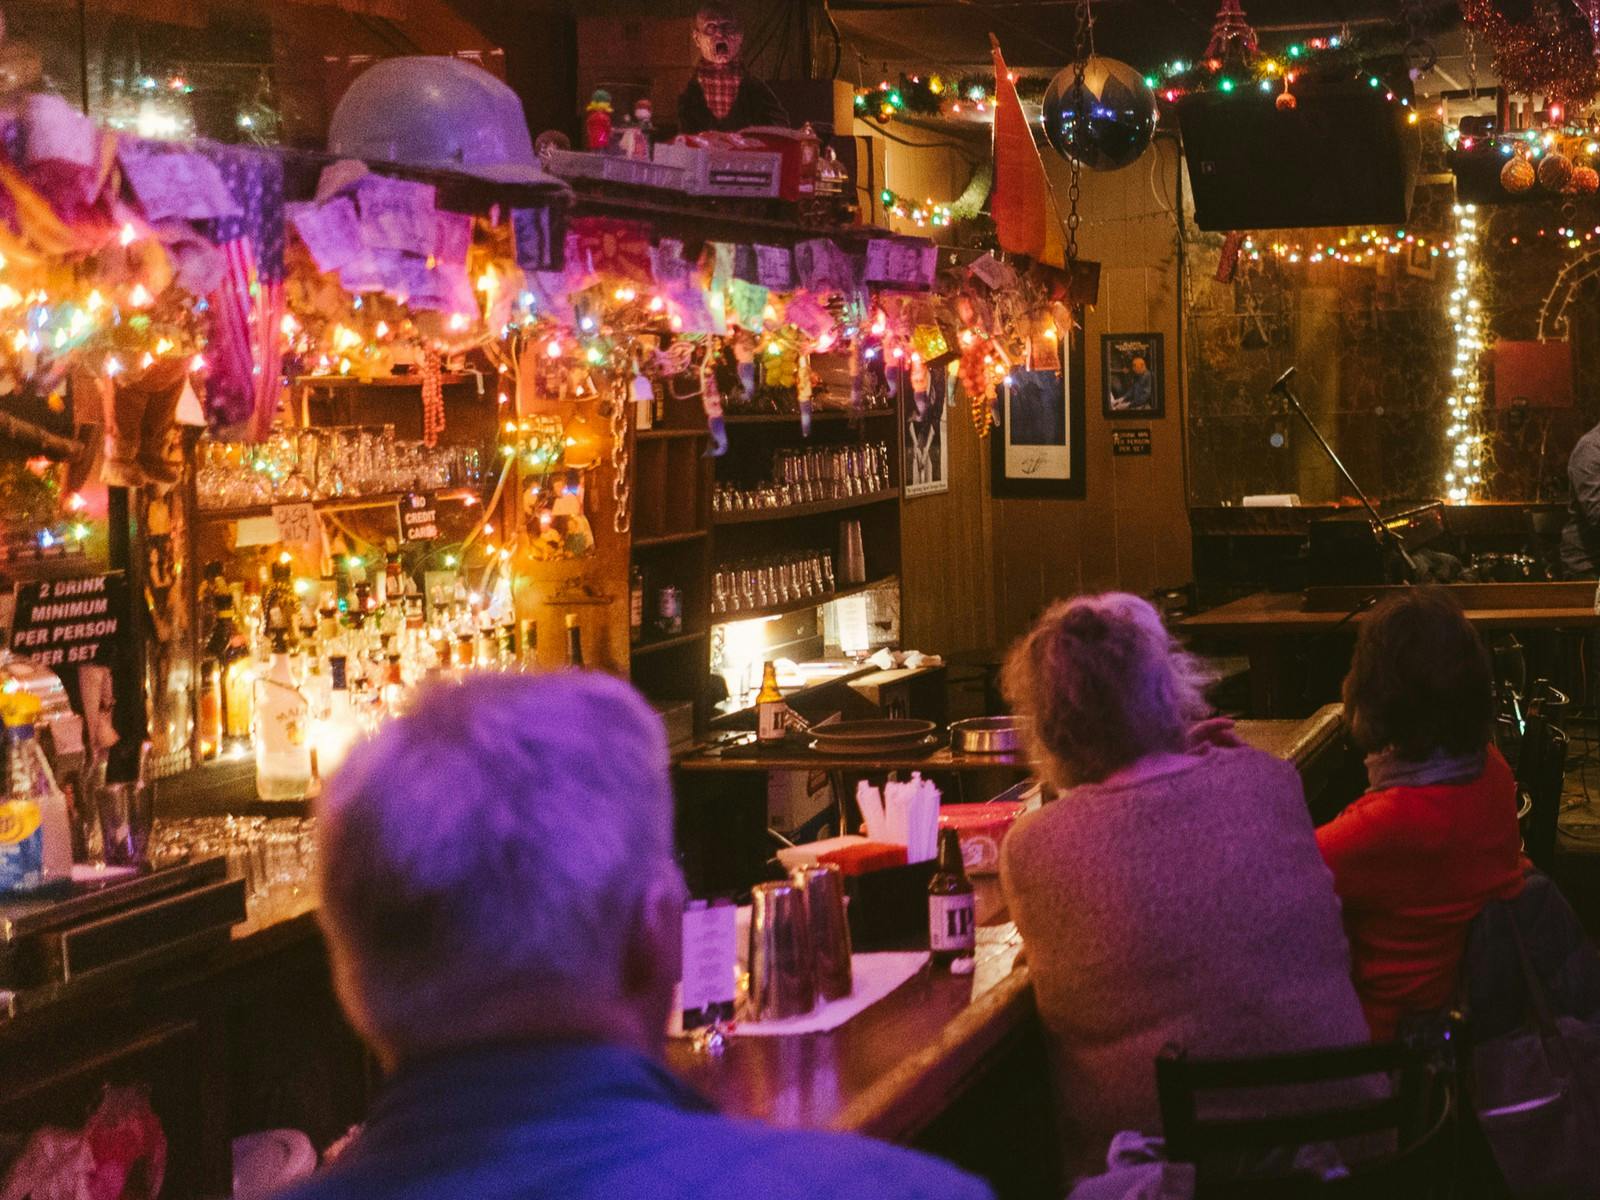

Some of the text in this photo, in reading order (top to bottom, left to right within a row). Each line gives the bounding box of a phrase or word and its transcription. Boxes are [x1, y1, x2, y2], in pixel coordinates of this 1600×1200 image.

[411, 495, 427, 508] NO
[405, 510, 436, 525] CREDIT
[408, 525, 438, 539] CARDS
[38, 576, 107, 599] 2 DRINK
[31, 598, 108, 622] MINIMUM
[14, 617, 118, 648] PER PERSON
[31, 642, 100, 666] PER SET
